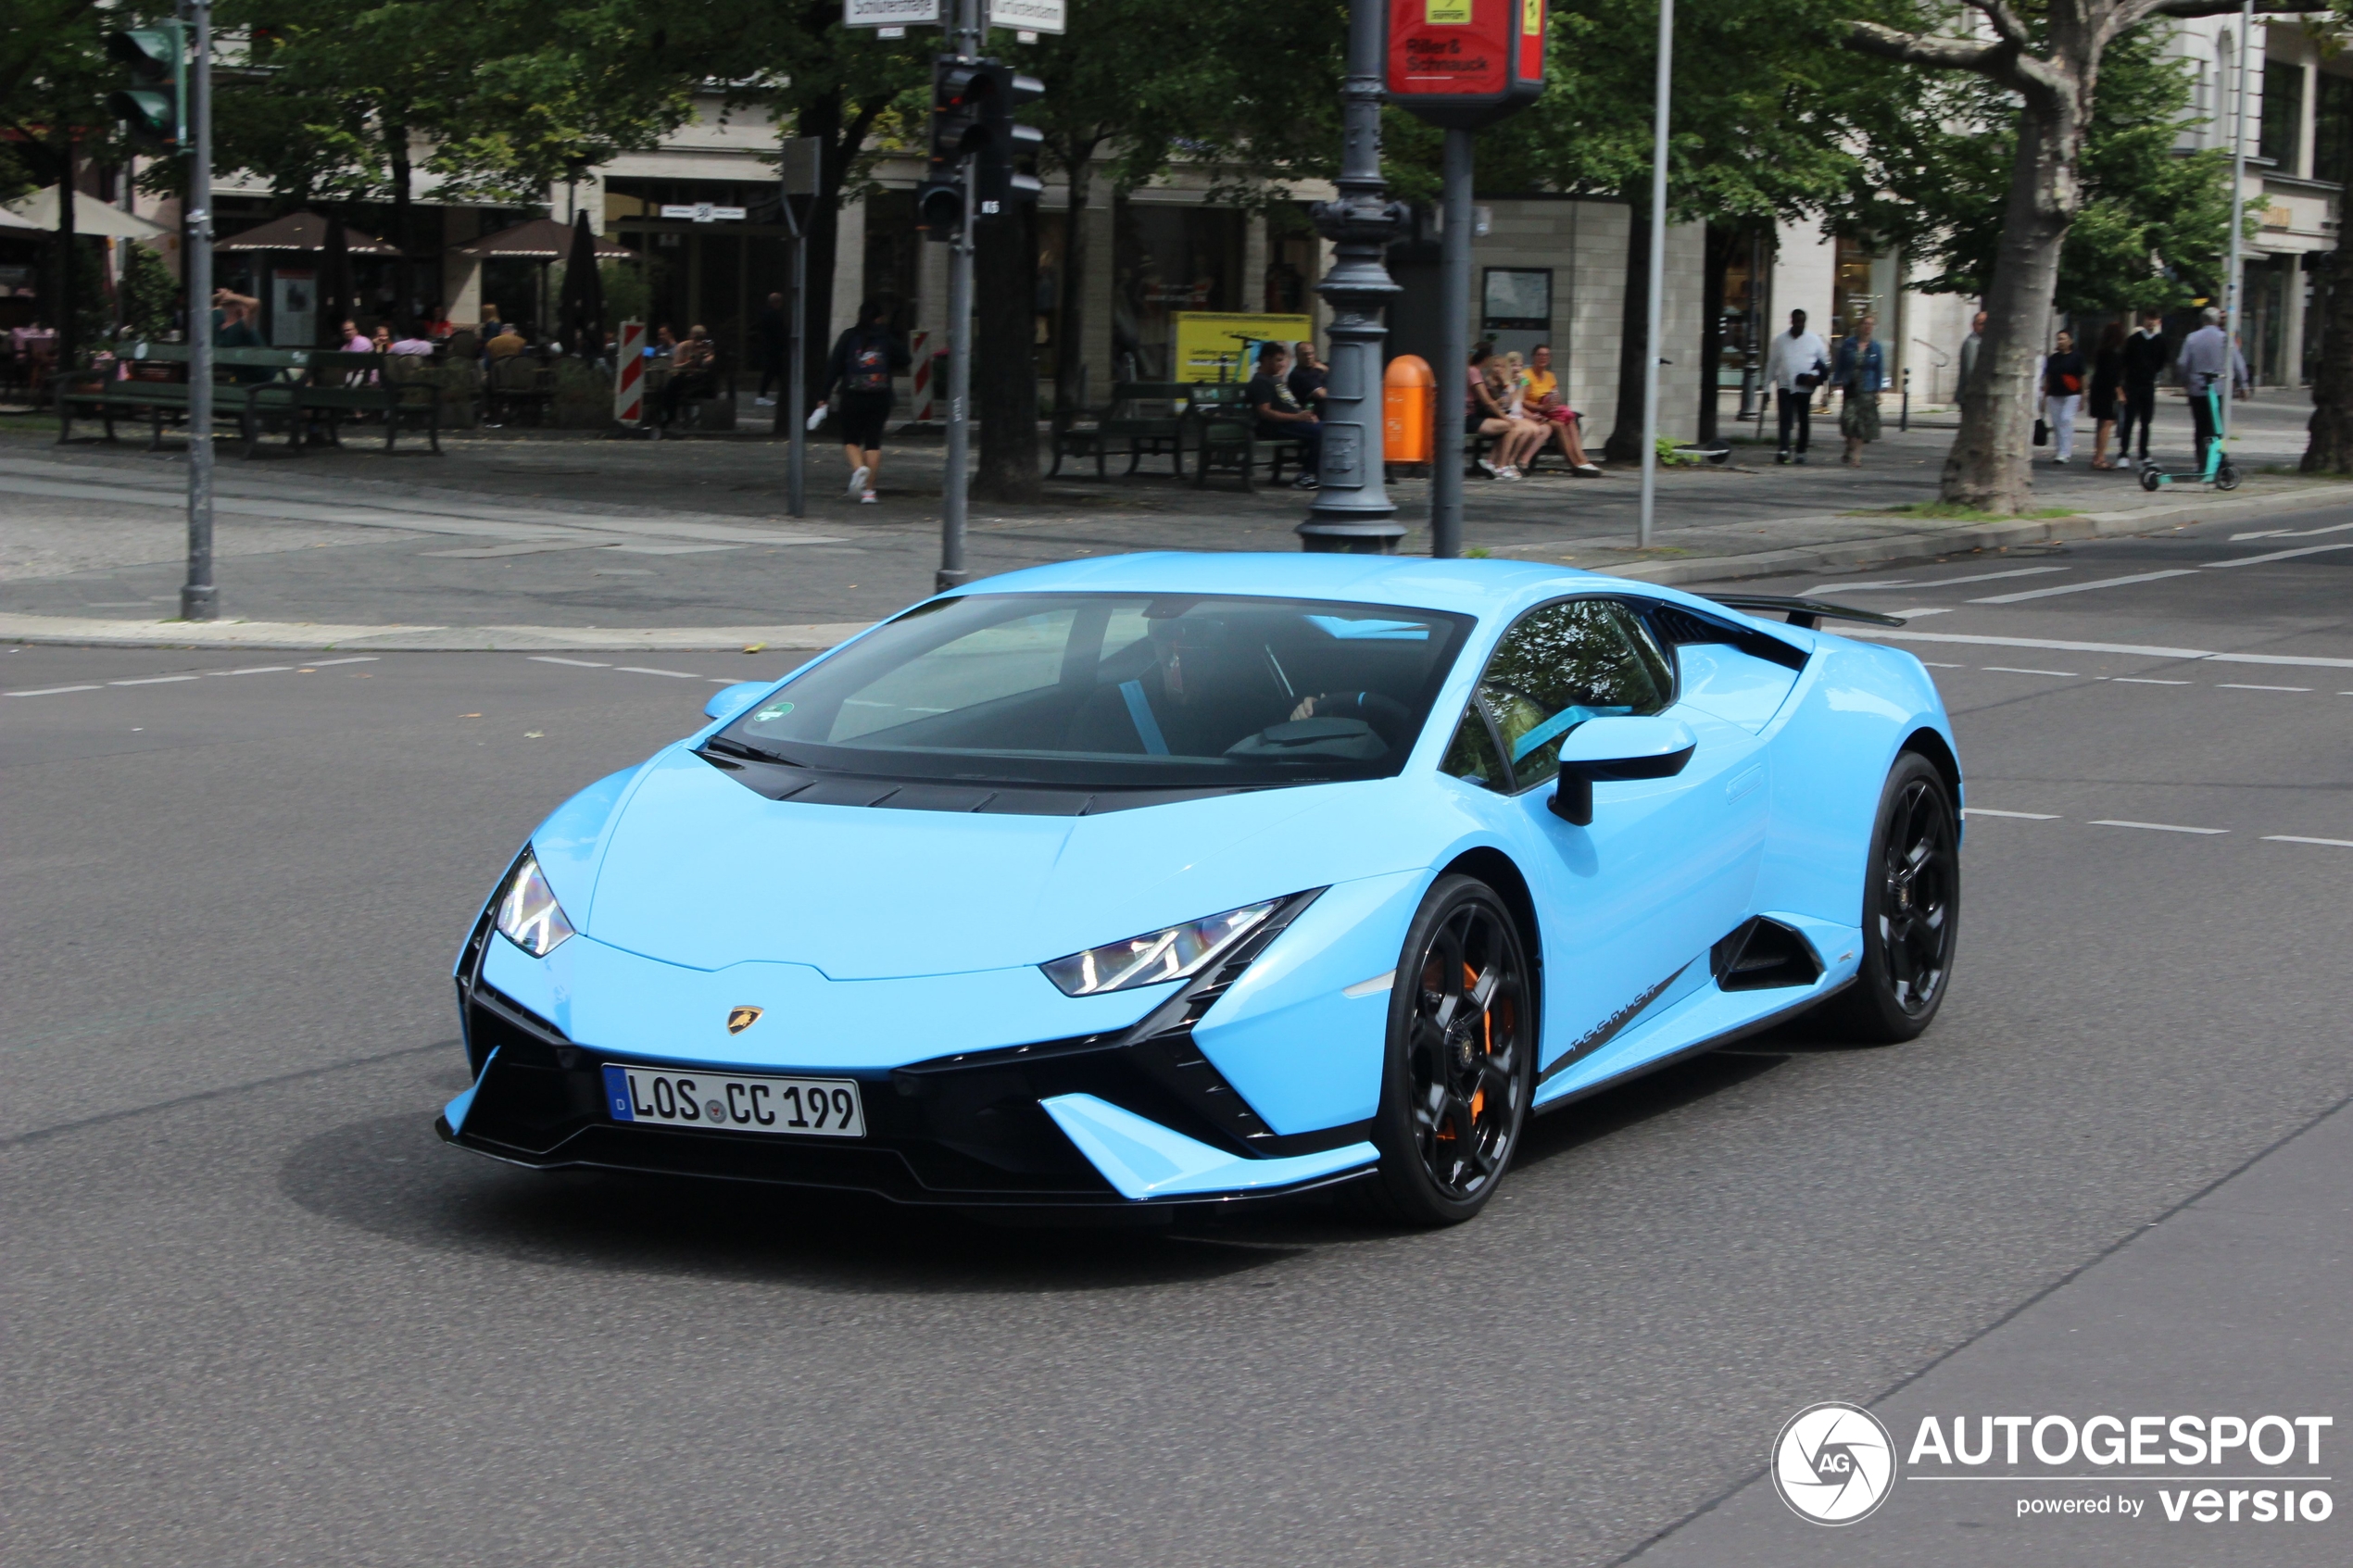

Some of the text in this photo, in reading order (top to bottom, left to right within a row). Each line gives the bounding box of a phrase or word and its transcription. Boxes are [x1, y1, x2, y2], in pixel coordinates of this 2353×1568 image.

[1405, 38, 1461, 54] Riller &
[1405, 56, 1488, 71] Schnauck
[1571, 984, 1655, 1051] TECNICA
[616, 1098, 626, 1110] D
[628, 1074, 854, 1129] LOS CC 199
